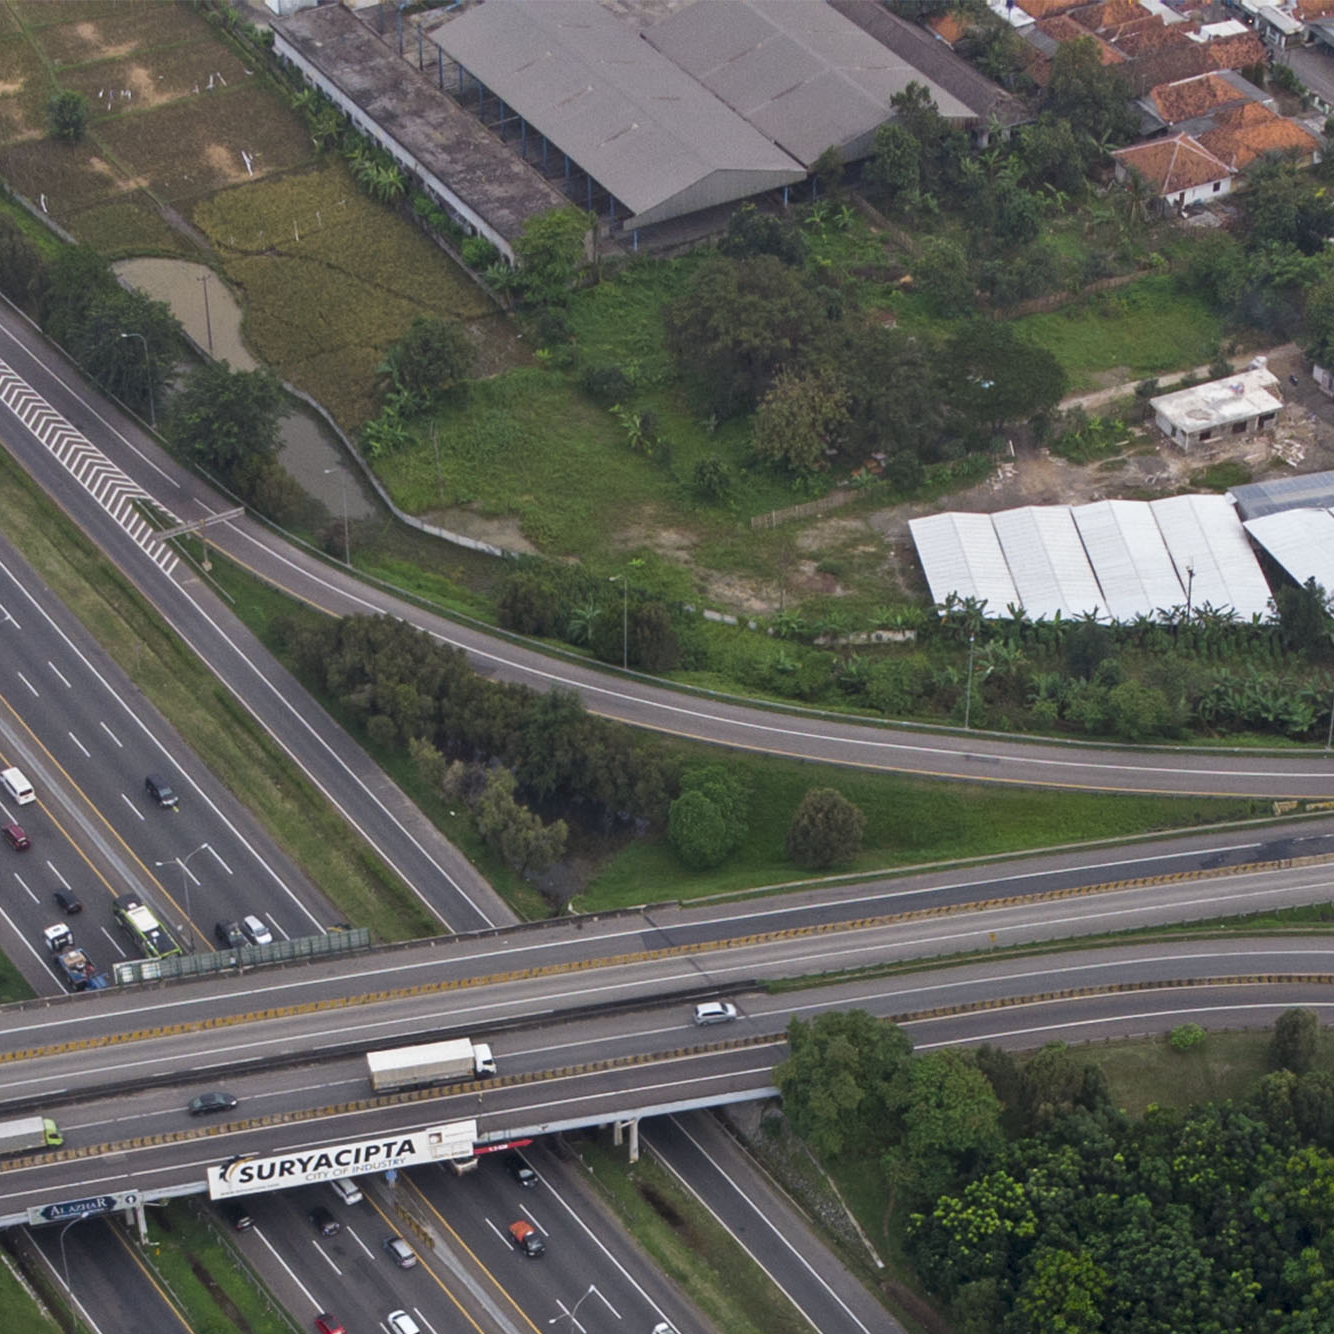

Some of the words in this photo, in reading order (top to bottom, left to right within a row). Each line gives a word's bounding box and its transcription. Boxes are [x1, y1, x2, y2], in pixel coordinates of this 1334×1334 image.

[239, 1139, 416, 1183] SURYACIPTA
[305, 1170, 329, 1181] CITY
[332, 1168, 349, 1177] OF
[352, 1157, 407, 1174] INDUSTRY
